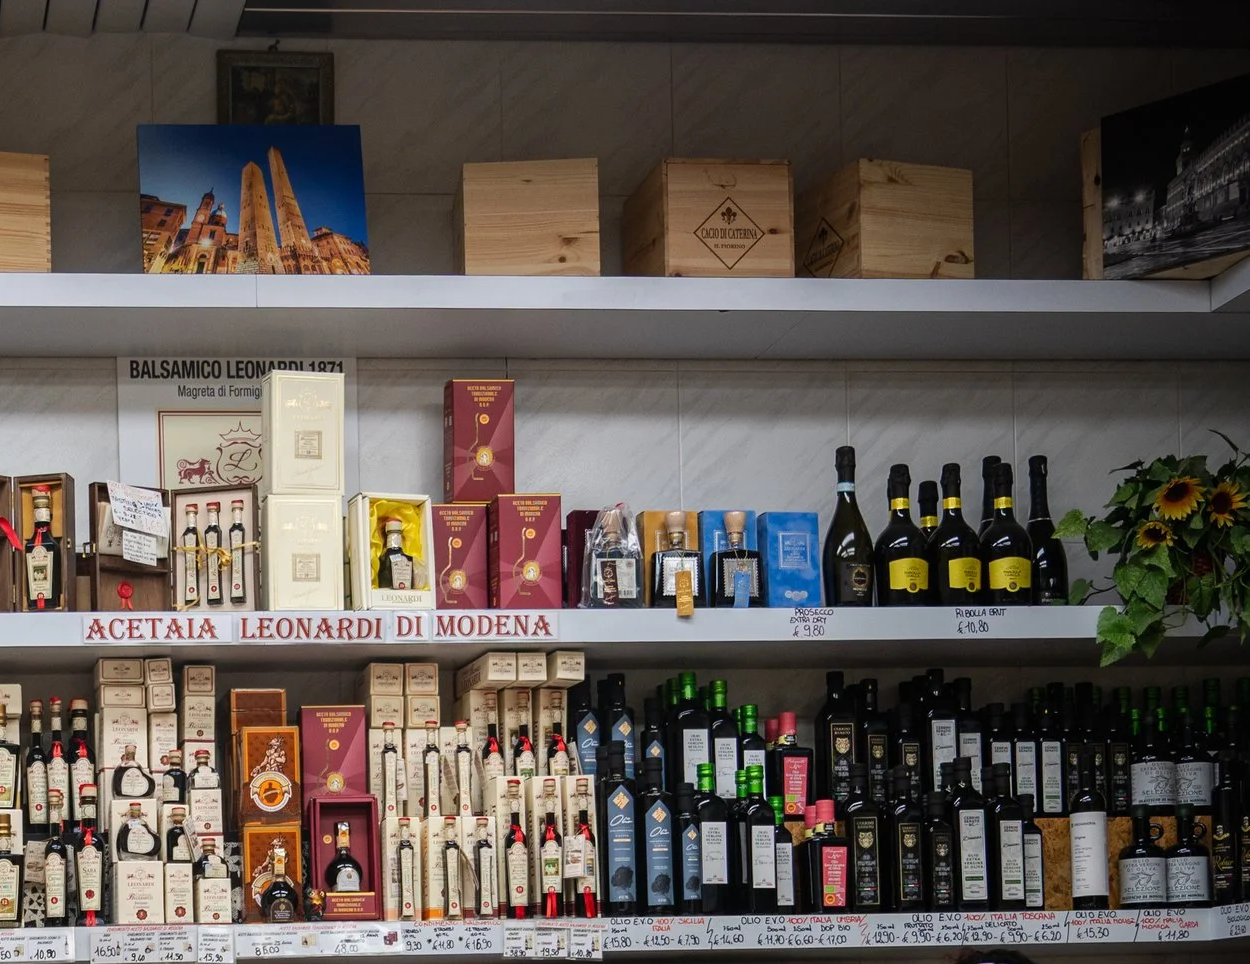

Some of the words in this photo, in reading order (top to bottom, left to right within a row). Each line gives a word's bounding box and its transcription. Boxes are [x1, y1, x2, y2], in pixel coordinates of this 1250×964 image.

[701, 228, 719, 239] CACIO
[720, 228, 727, 239] DI
[728, 228, 758, 240] CATERINA
[129, 360, 222, 380] BALSAMICO
[226, 360, 304, 379] LEONARDI
[177, 385, 216, 400] Magreta
[218, 384, 227, 398] di
[229, 385, 262, 400] Formigi
[381, 594, 422, 602] LEONARDI
[794, 608, 834, 617] PROSECCO
[955, 608, 986, 619] RIBOLLA
[988, 608, 1006, 617] BRUT
[790, 616, 810, 624] EXTRA
[812, 616, 828, 624] DRY
[86, 618, 220, 640] ACETAIA
[240, 617, 382, 640] LEONARDI
[396, 616, 422, 637] DI
[435, 615, 553, 637] MODENA
[741, 916, 760, 924] OLIO
[810, 916, 832, 924] ITALIA
[836, 916, 862, 924] UMBRIA
[912, 914, 932, 922] OLIO
[1020, 912, 1056, 920] TOSCANA
[610, 918, 630, 926] OLIO
[820, 924, 835, 932] DOP
